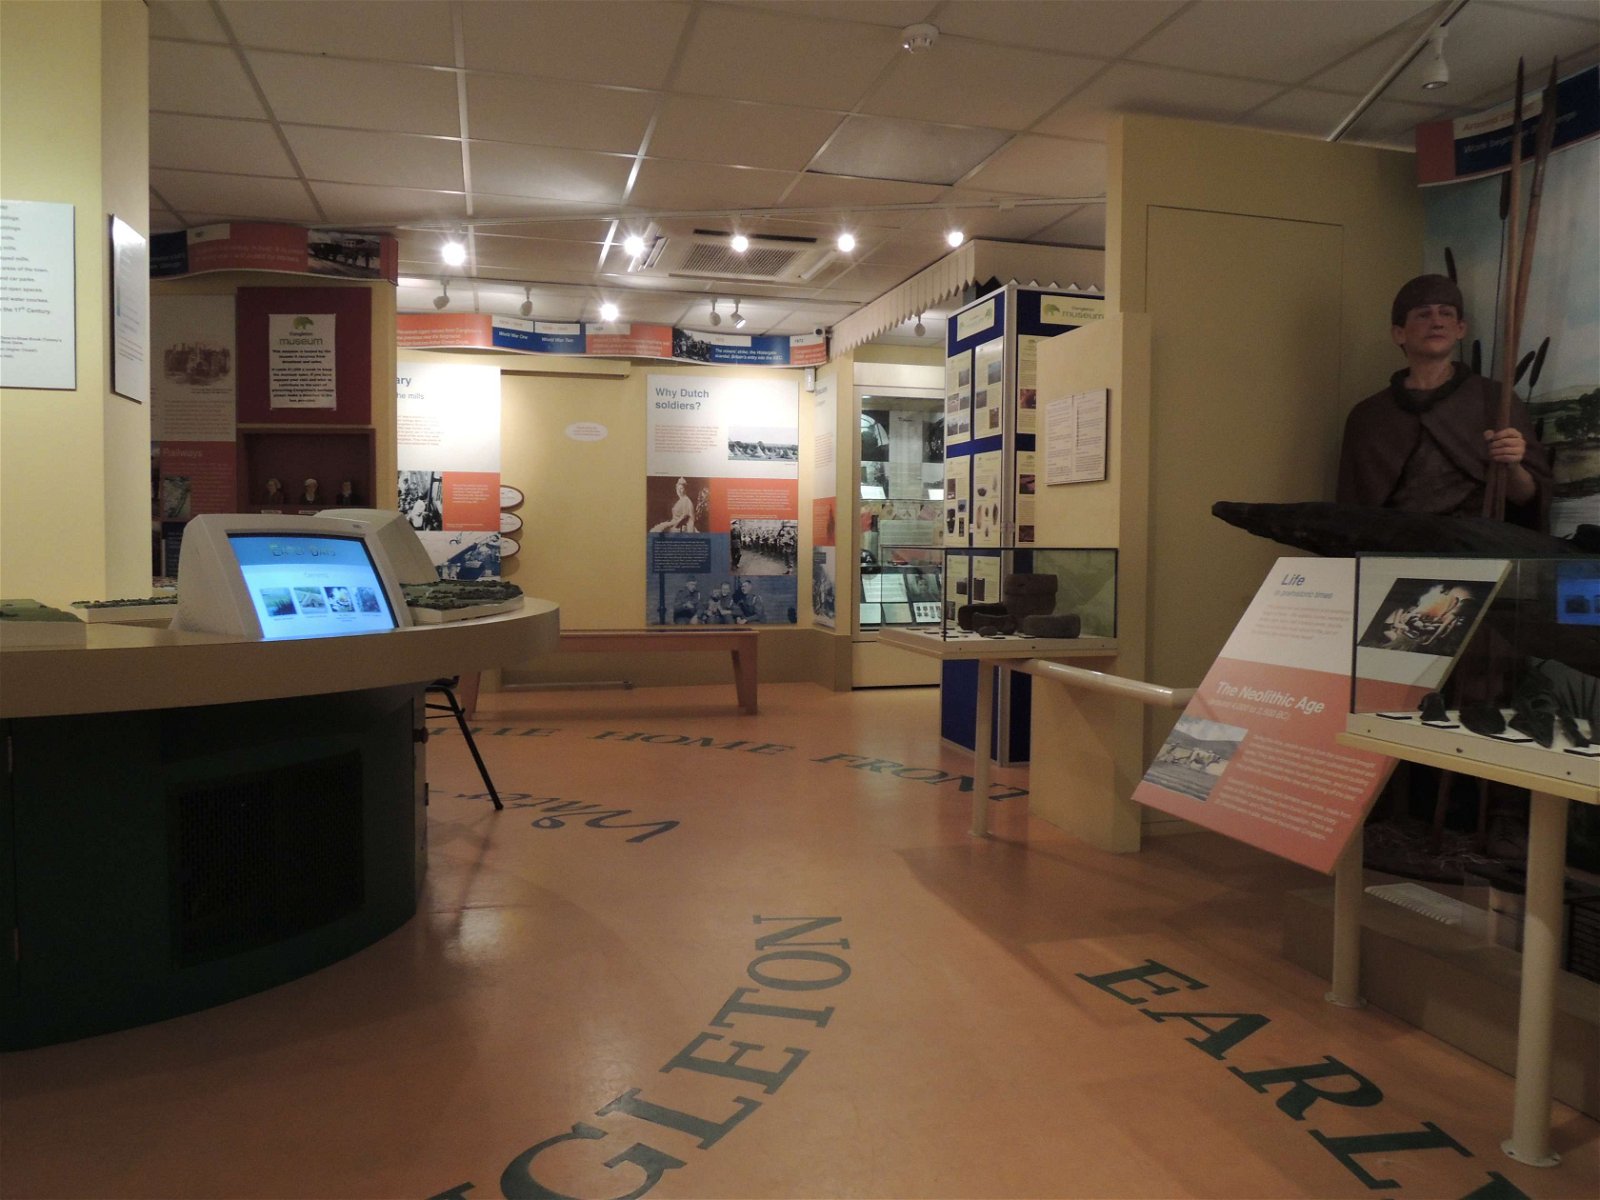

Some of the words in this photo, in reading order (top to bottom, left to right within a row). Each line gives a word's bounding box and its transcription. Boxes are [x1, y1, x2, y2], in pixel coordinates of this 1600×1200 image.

[1062, 311, 1105, 320] museum
[279, 338, 324, 346] museum
[407, 391, 425, 401] mills
[655, 387, 677, 399] Why
[680, 387, 710, 399] Dutch
[655, 400, 702, 411] soldiers?
[1281, 574, 1306, 586] Life
[1215, 681, 1239, 697] The
[1238, 685, 1296, 708] Neolithic
[1294, 695, 1326, 716] Age
[587, 730, 797, 757] HOME
